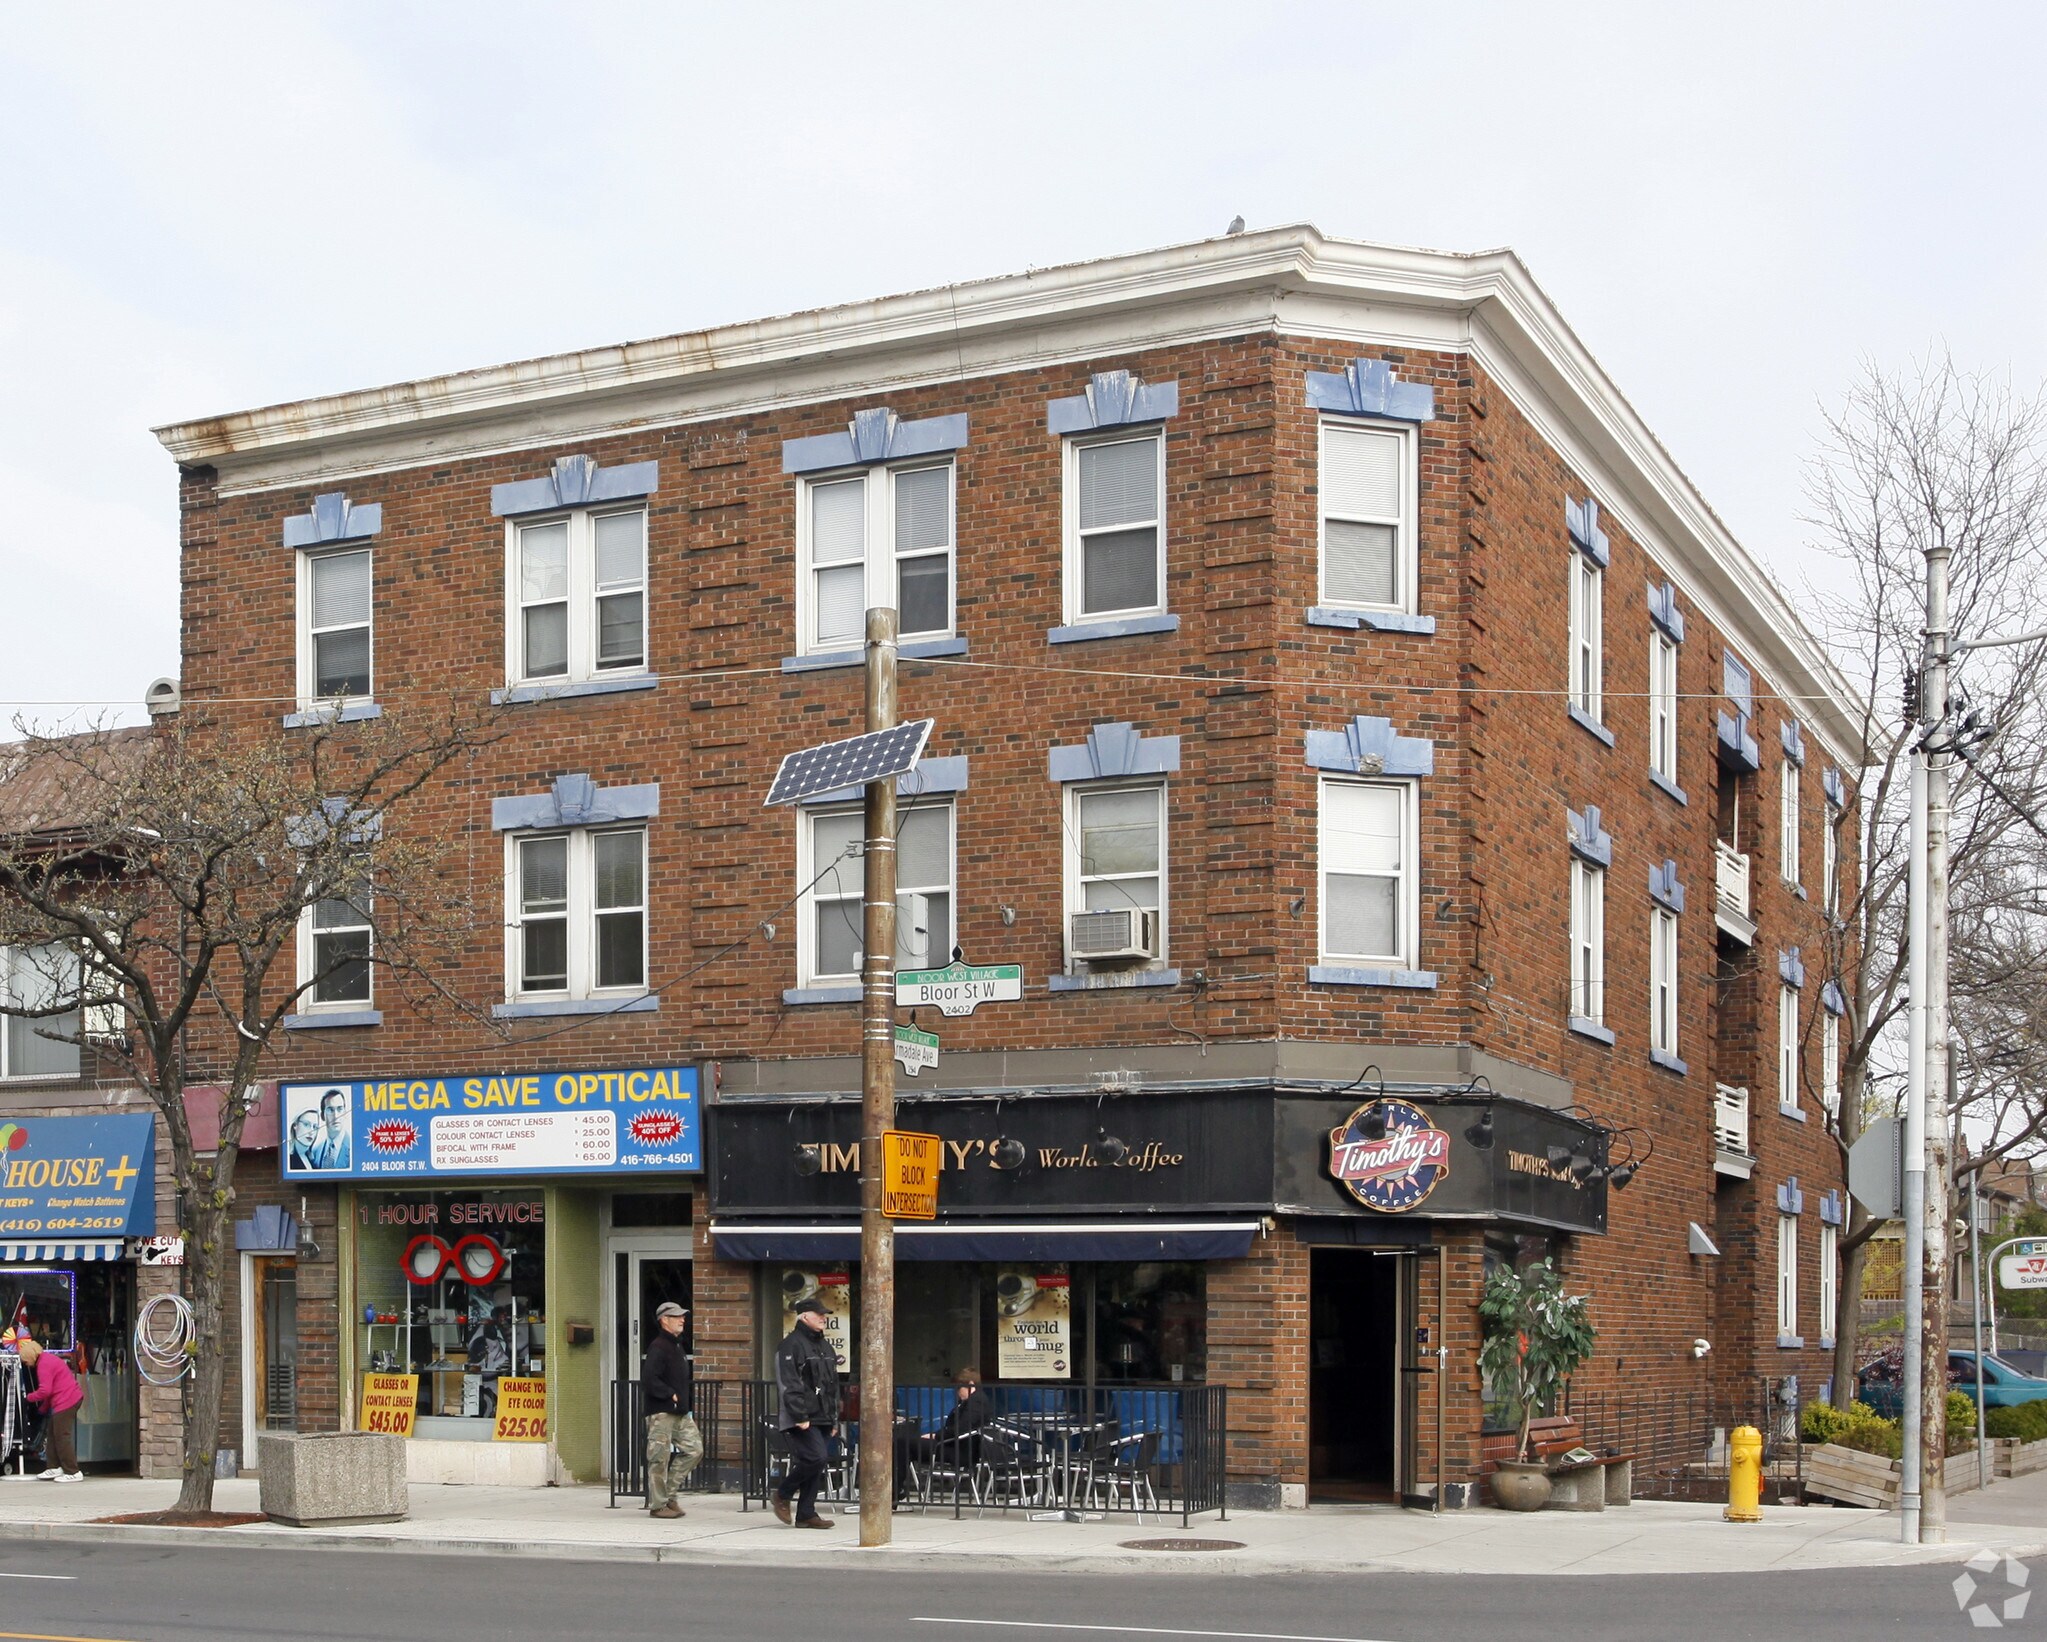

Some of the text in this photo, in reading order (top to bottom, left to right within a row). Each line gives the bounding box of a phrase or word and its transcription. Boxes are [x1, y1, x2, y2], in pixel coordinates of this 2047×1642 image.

[947, 971, 967, 982] WEST
[970, 969, 999, 980] VILLAGE
[920, 981, 996, 1001] Bloor St W
[945, 1004, 971, 1015] 2402
[896, 1043, 933, 1063] rmadale Ave
[363, 1070, 691, 1112] MEGA SAVE OPTICAL
[435, 1120, 471, 1129] GLASSES
[473, 1119, 484, 1128] OR
[487, 1118, 521, 1127] CONTACT
[524, 1117, 554, 1126] LENSES
[582, 1115, 610, 1124] 45.00
[435, 1132, 467, 1141] COLOUR
[469, 1131, 503, 1140] CONTACT
[506, 1130, 536, 1139] LENSES
[582, 1128, 610, 1137] 25.00
[658, 1126, 672, 1134] OFF
[436, 1144, 467, 1153] BIFOCAL
[470, 1143, 489, 1151] WITH
[491, 1142, 517, 1151] FRAME
[582, 1140, 611, 1149] 60.00
[899, 1138, 928, 1159] DO NOT
[1335, 1124, 1443, 1178] Timothy's
[436, 1156, 447, 1165] RX
[449, 1155, 499, 1164] SUNGLASSES
[582, 1152, 611, 1161] 65.00
[620, 1153, 693, 1165] 416-766-4501
[361, 1161, 379, 1172] 2404
[381, 1160, 406, 1171] BLOOR
[5, 1157, 105, 1189] HOUSE
[901, 1165, 926, 1186] BLOCK
[47, 1197, 72, 1209] Change
[73, 1196, 94, 1207] Watch
[886, 1191, 936, 1213] INTERSECTION
[1359, 1187, 1422, 1207] COFFEE
[359, 1202, 545, 1225] 1 HOUR SERVICE
[0, 1217, 124, 1233] (416) 604-2619
[143, 1235, 179, 1246] WE CUT
[160, 1254, 184, 1265] KEYS
[1013, 1320, 1060, 1335] world
[826, 1337, 845, 1349] ug
[373, 1378, 409, 1391] GLASSES OR
[503, 1381, 547, 1394] CHANGE YOU
[365, 1394, 414, 1408] CONTACT LENSES
[507, 1397, 545, 1410] EYE COLOR
[368, 1410, 409, 1434] $45.00
